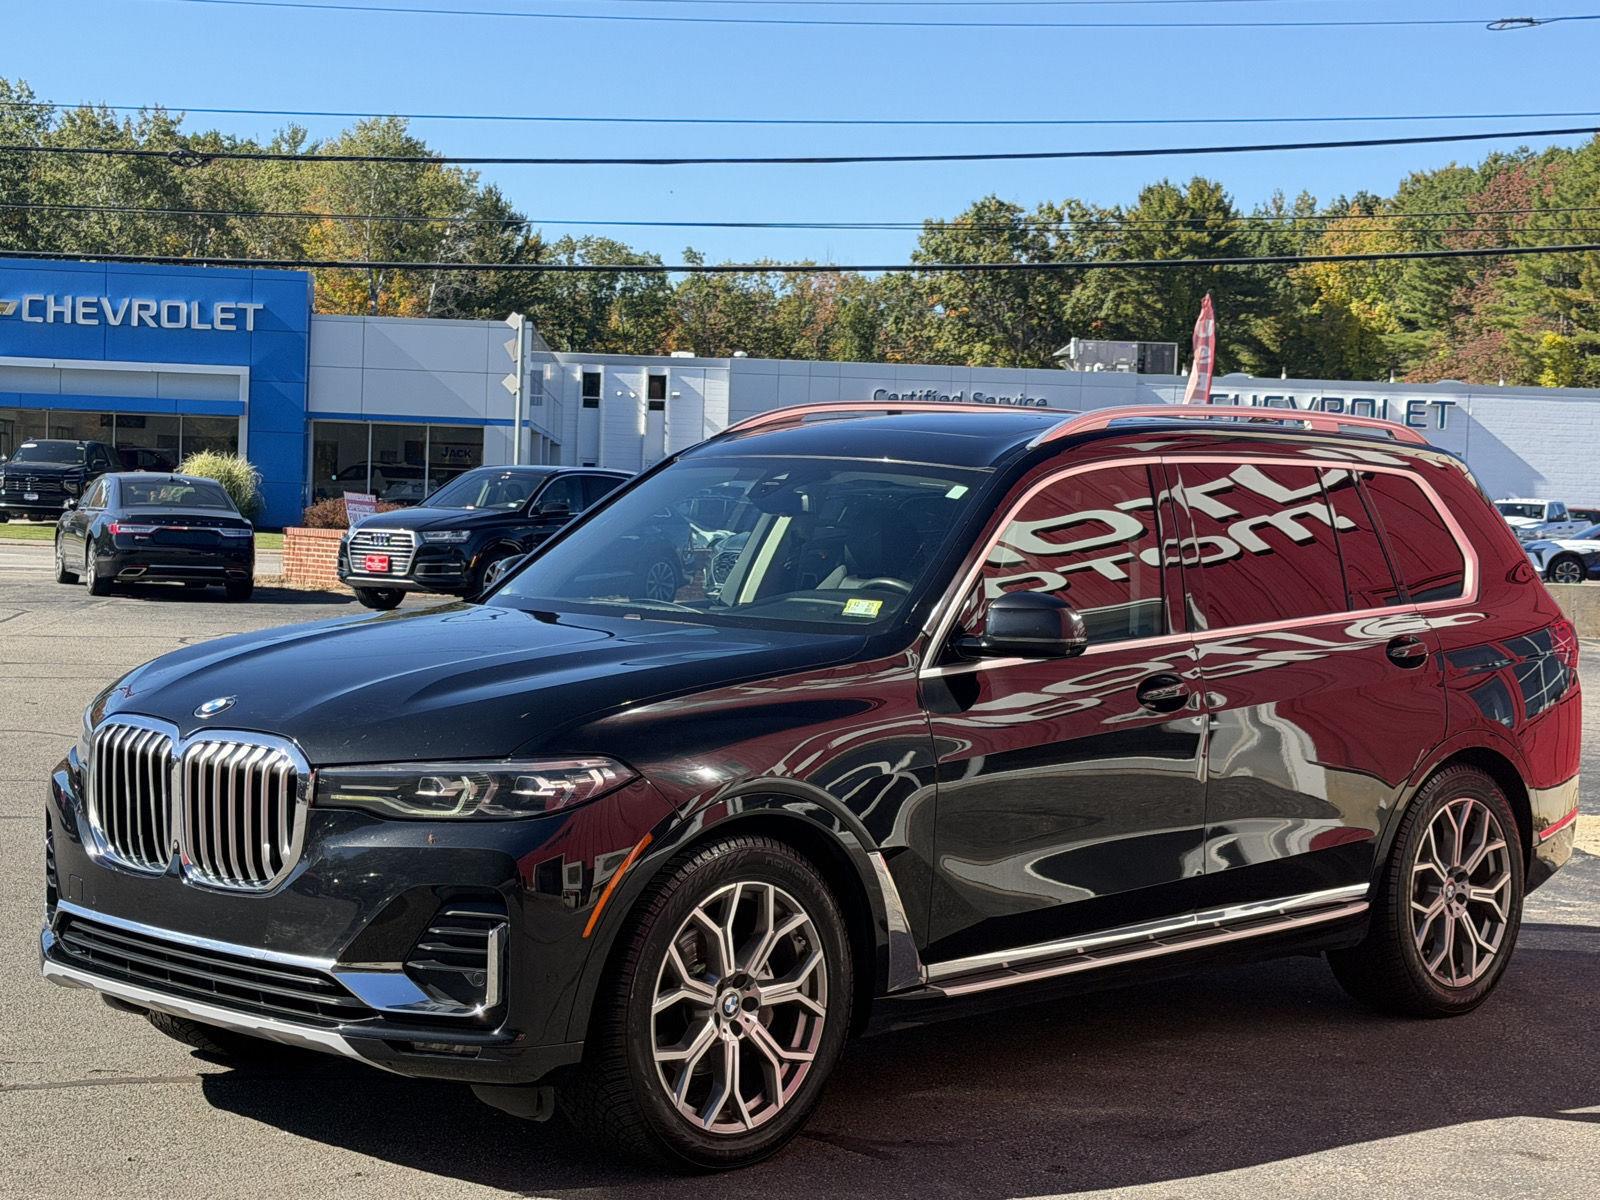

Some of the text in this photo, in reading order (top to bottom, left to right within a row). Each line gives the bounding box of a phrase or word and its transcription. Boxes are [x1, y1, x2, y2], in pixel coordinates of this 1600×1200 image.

[22, 294, 264, 331] CHEVROLET
[873, 389, 1048, 407] Certified Service
[442, 446, 472, 458] JACK
